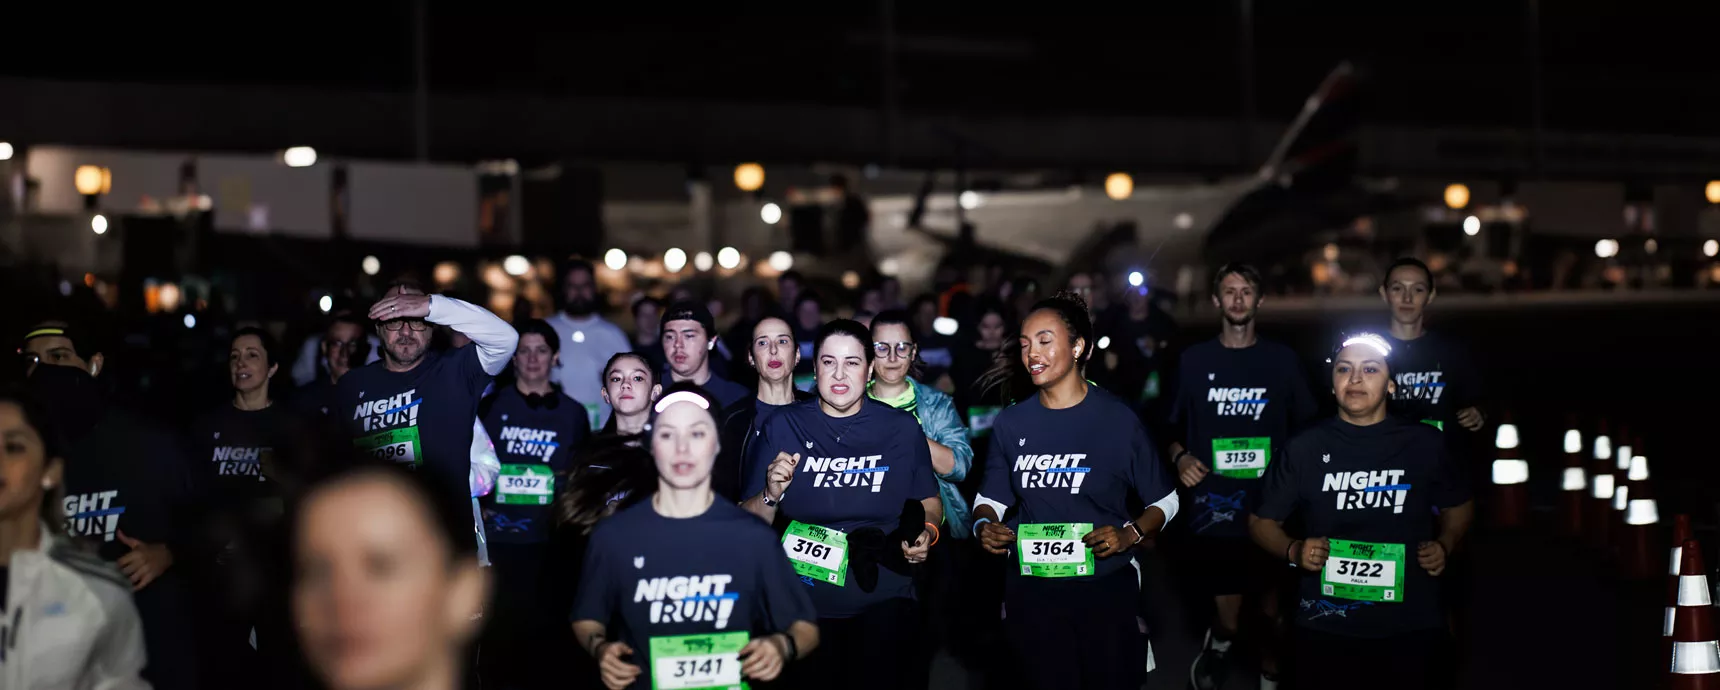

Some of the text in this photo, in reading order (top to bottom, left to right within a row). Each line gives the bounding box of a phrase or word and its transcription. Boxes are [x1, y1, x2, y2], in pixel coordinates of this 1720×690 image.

[1207, 387, 1267, 402] NIGHT
[353, 388, 416, 421] NIGHT
[1217, 402, 1266, 421] RUN!
[363, 404, 419, 432] RUN!
[500, 425, 558, 442] NIGHT
[371, 443, 407, 459] 096
[506, 440, 556, 463] RUN!
[1224, 451, 1256, 464] 3139
[802, 454, 882, 472] NIGHT
[1013, 453, 1087, 472] NIGHT
[505, 477, 541, 488] 3037
[813, 471, 885, 493] RUN!
[1021, 471, 1086, 494] RUN!
[1321, 469, 1406, 493] NIGHT
[63, 489, 119, 517] GHT
[1336, 489, 1408, 514] RUN!
[1042, 525, 1065, 533] NIGHT
[792, 538, 832, 561] 3161
[1031, 541, 1075, 556] 3164
[1349, 543, 1374, 553] NIGHT
[1336, 560, 1384, 578] 3122
[633, 574, 732, 603] NIGHT
[1386, 591, 1393, 599] 3
[649, 598, 735, 630] RUN!
[673, 658, 723, 678] 3141
